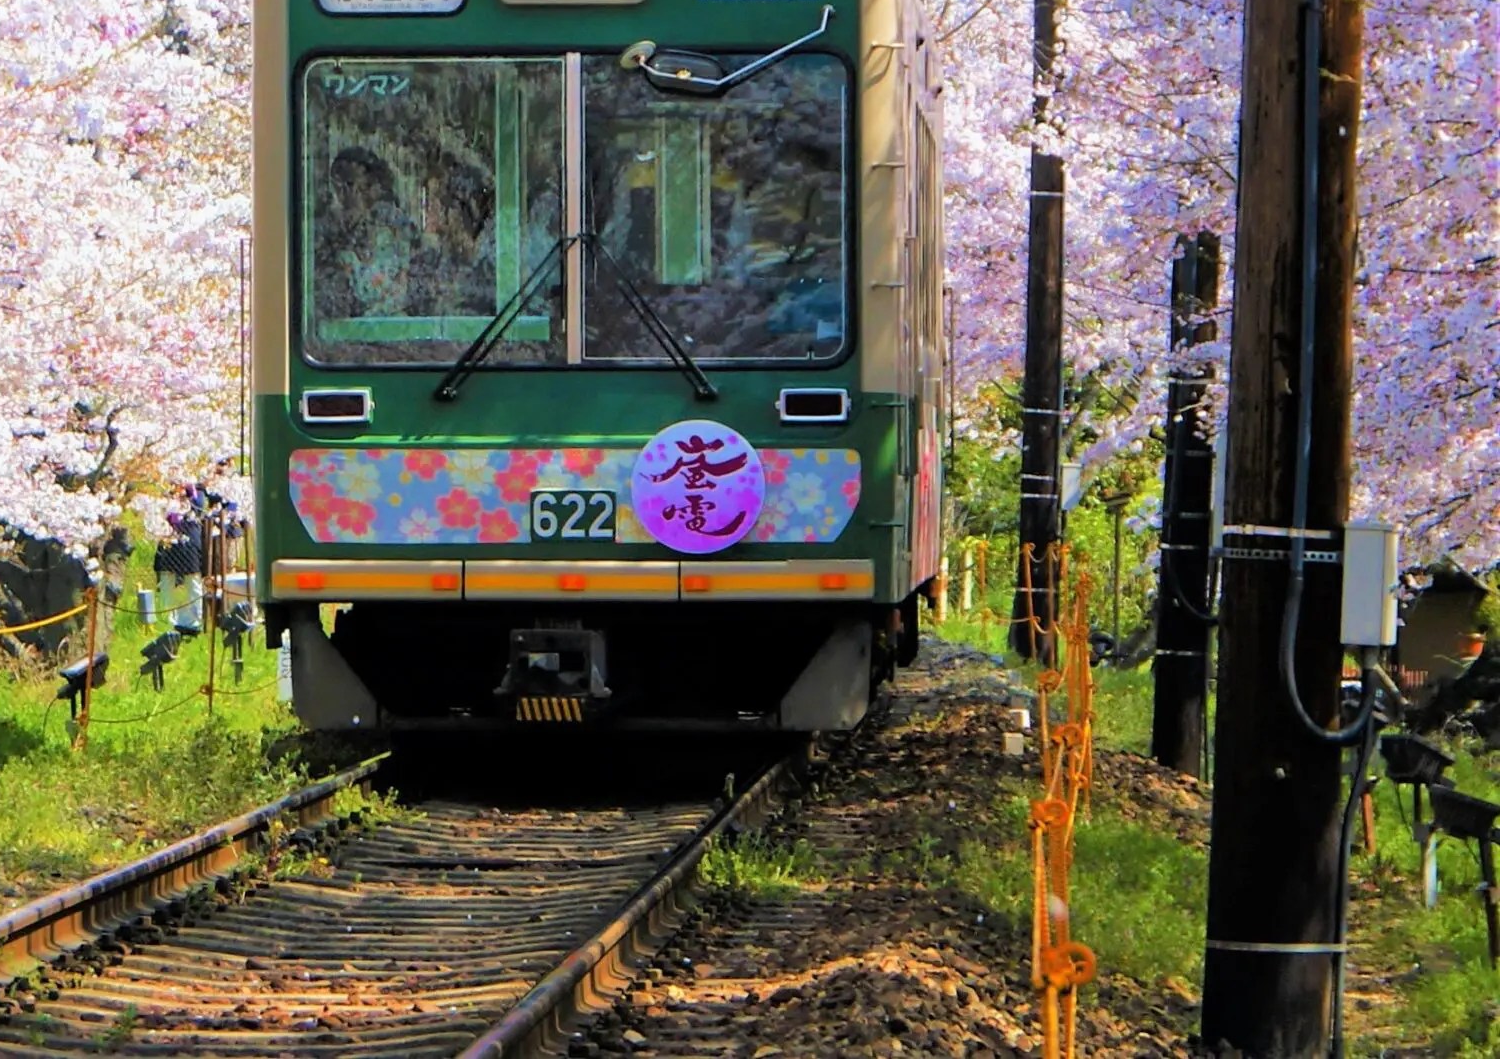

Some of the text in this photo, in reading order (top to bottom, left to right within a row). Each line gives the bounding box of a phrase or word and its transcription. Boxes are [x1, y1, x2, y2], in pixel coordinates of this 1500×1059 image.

[324, 74, 410, 95] ワンマン
[532, 492, 614, 538] 622
